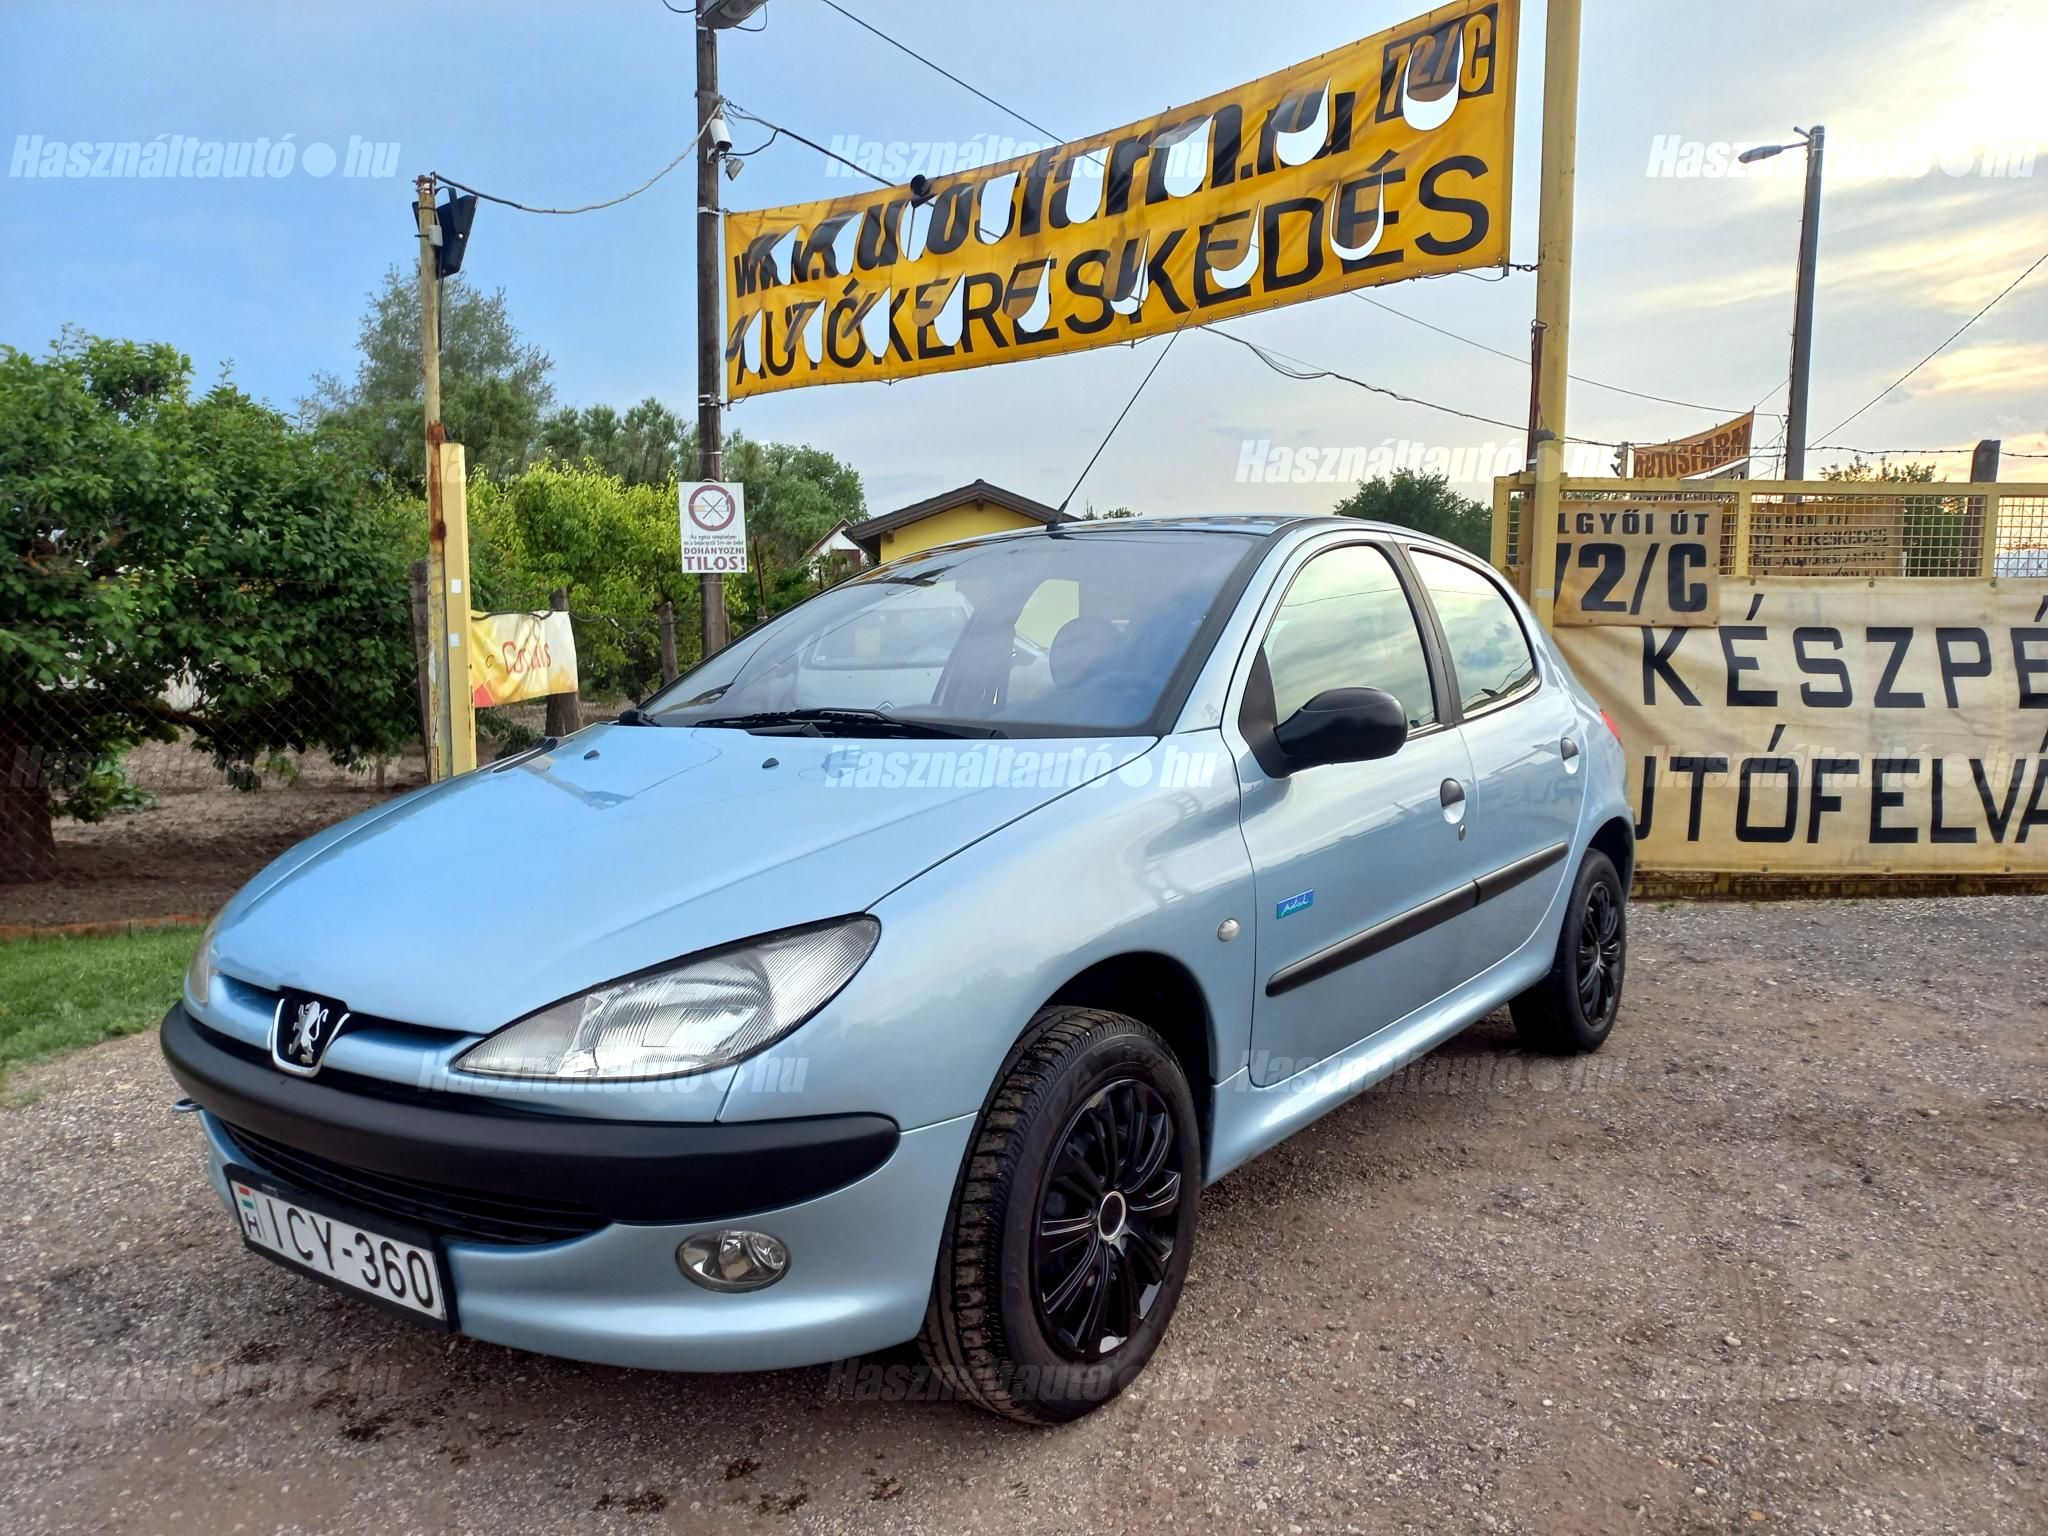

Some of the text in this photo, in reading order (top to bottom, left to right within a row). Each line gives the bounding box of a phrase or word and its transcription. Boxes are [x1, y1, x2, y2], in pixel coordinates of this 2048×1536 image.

[1670, 509, 1709, 535] ÚT
[684, 556, 746, 571] TILOS!
[265, 1198, 434, 1310] ICY-360
